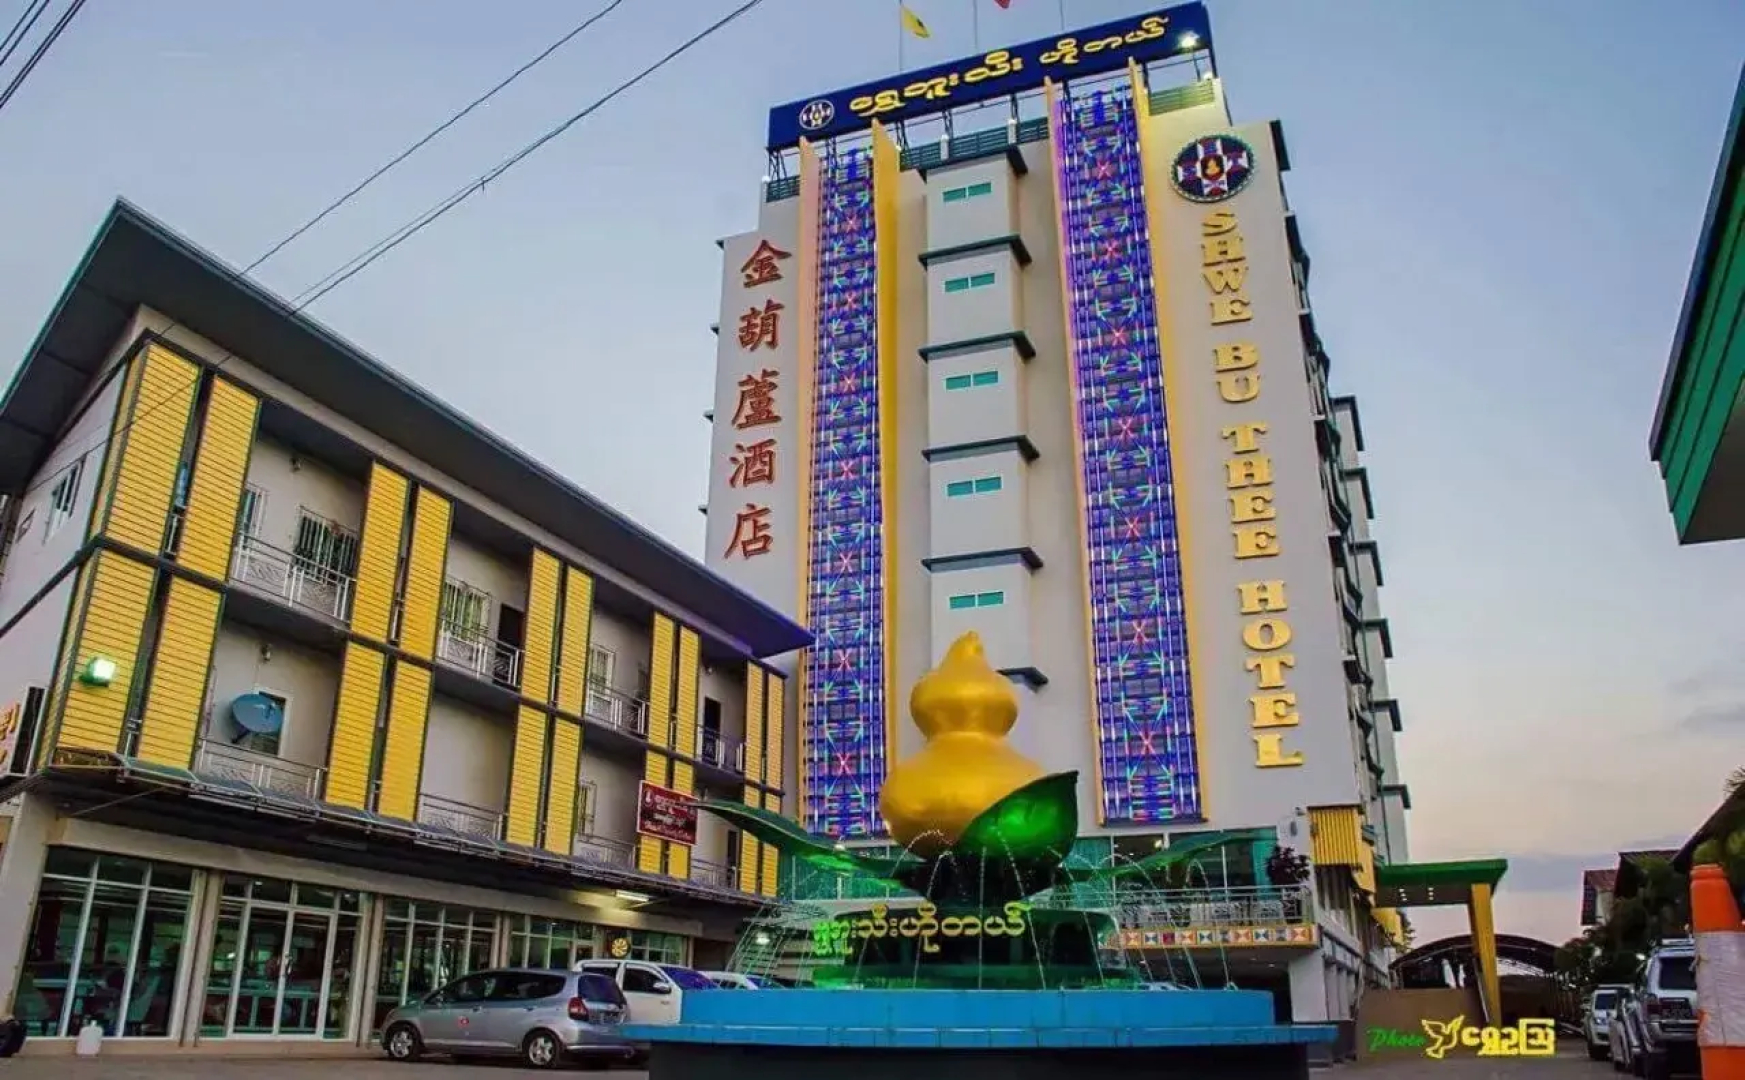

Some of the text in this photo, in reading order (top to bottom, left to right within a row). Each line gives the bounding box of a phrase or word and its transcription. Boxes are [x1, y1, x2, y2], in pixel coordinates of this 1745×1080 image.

[724, 239, 792, 560] 金葫蘆酒店
[1200, 212, 1304, 768] SHWE BU THEE HOTEL
